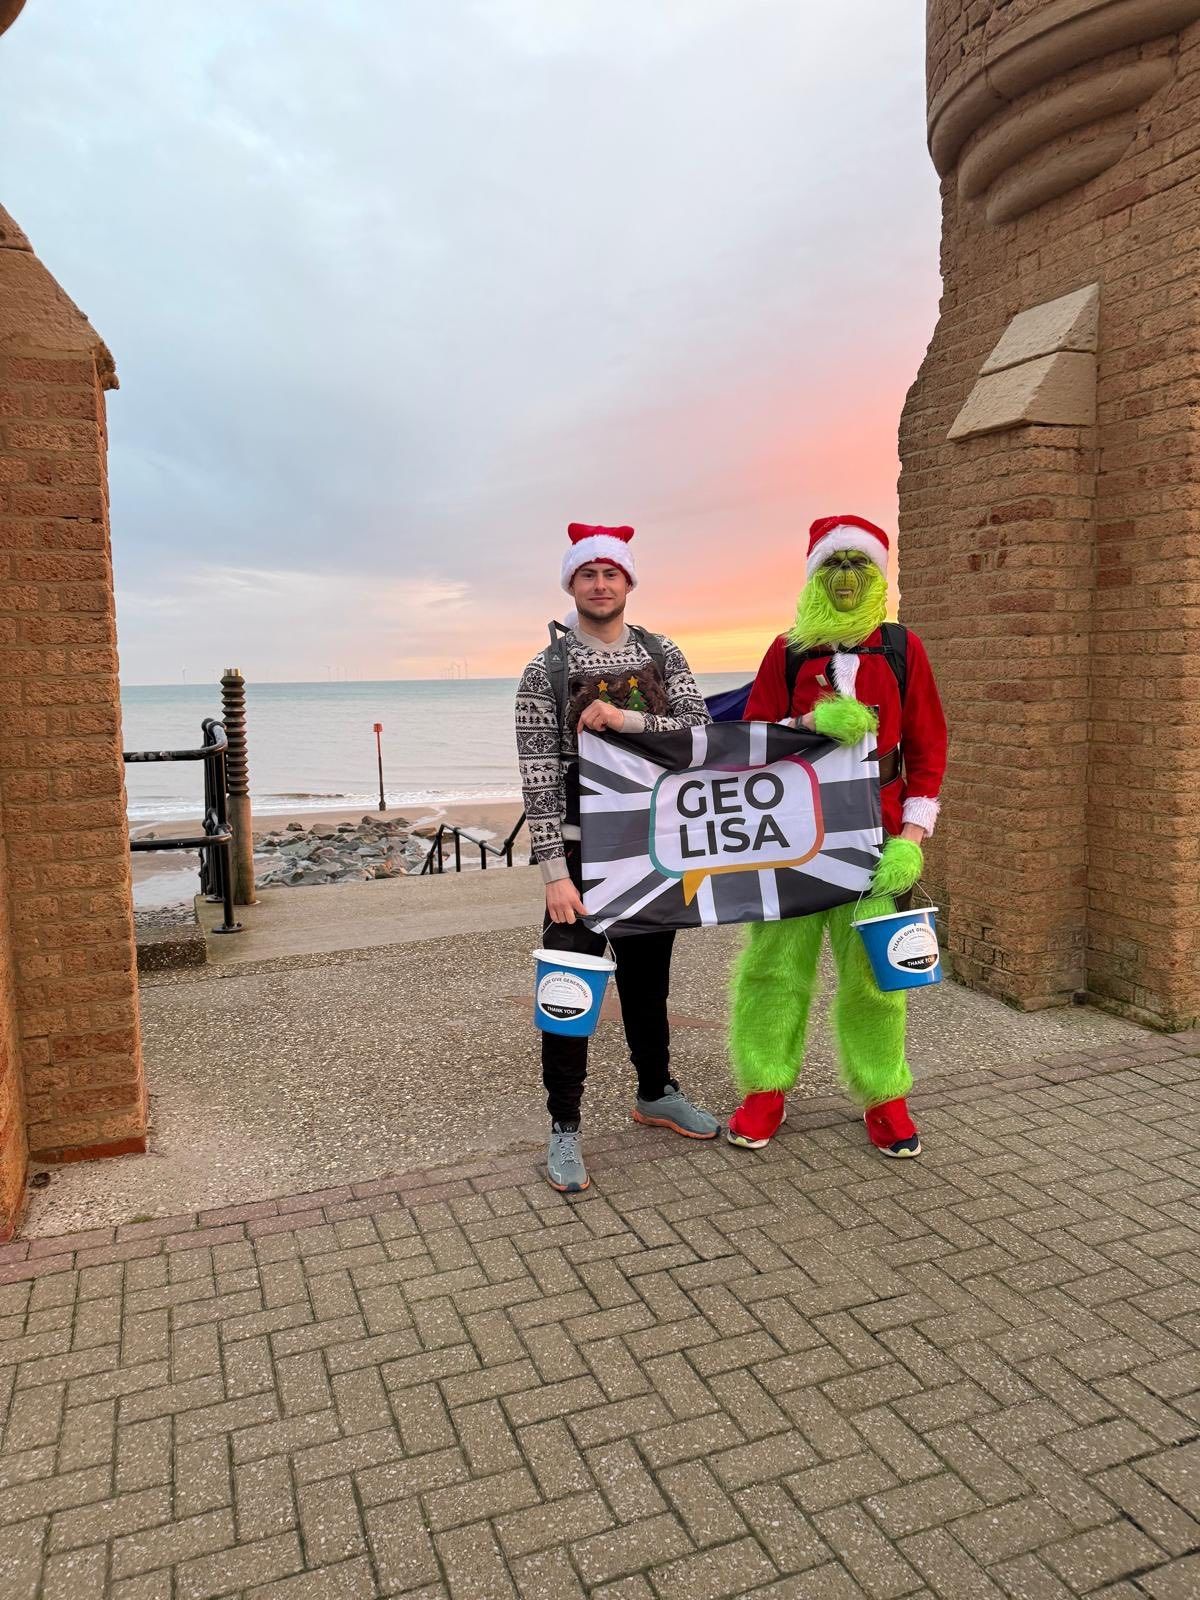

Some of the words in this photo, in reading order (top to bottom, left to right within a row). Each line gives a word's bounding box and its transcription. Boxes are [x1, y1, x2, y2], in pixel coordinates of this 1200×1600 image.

[676, 772, 785, 819] GEO
[679, 814, 791, 859] LISA
[892, 936, 904, 952] PLEASE
[904, 928, 915, 937] GIVE
[547, 1006, 563, 1014] THANK
